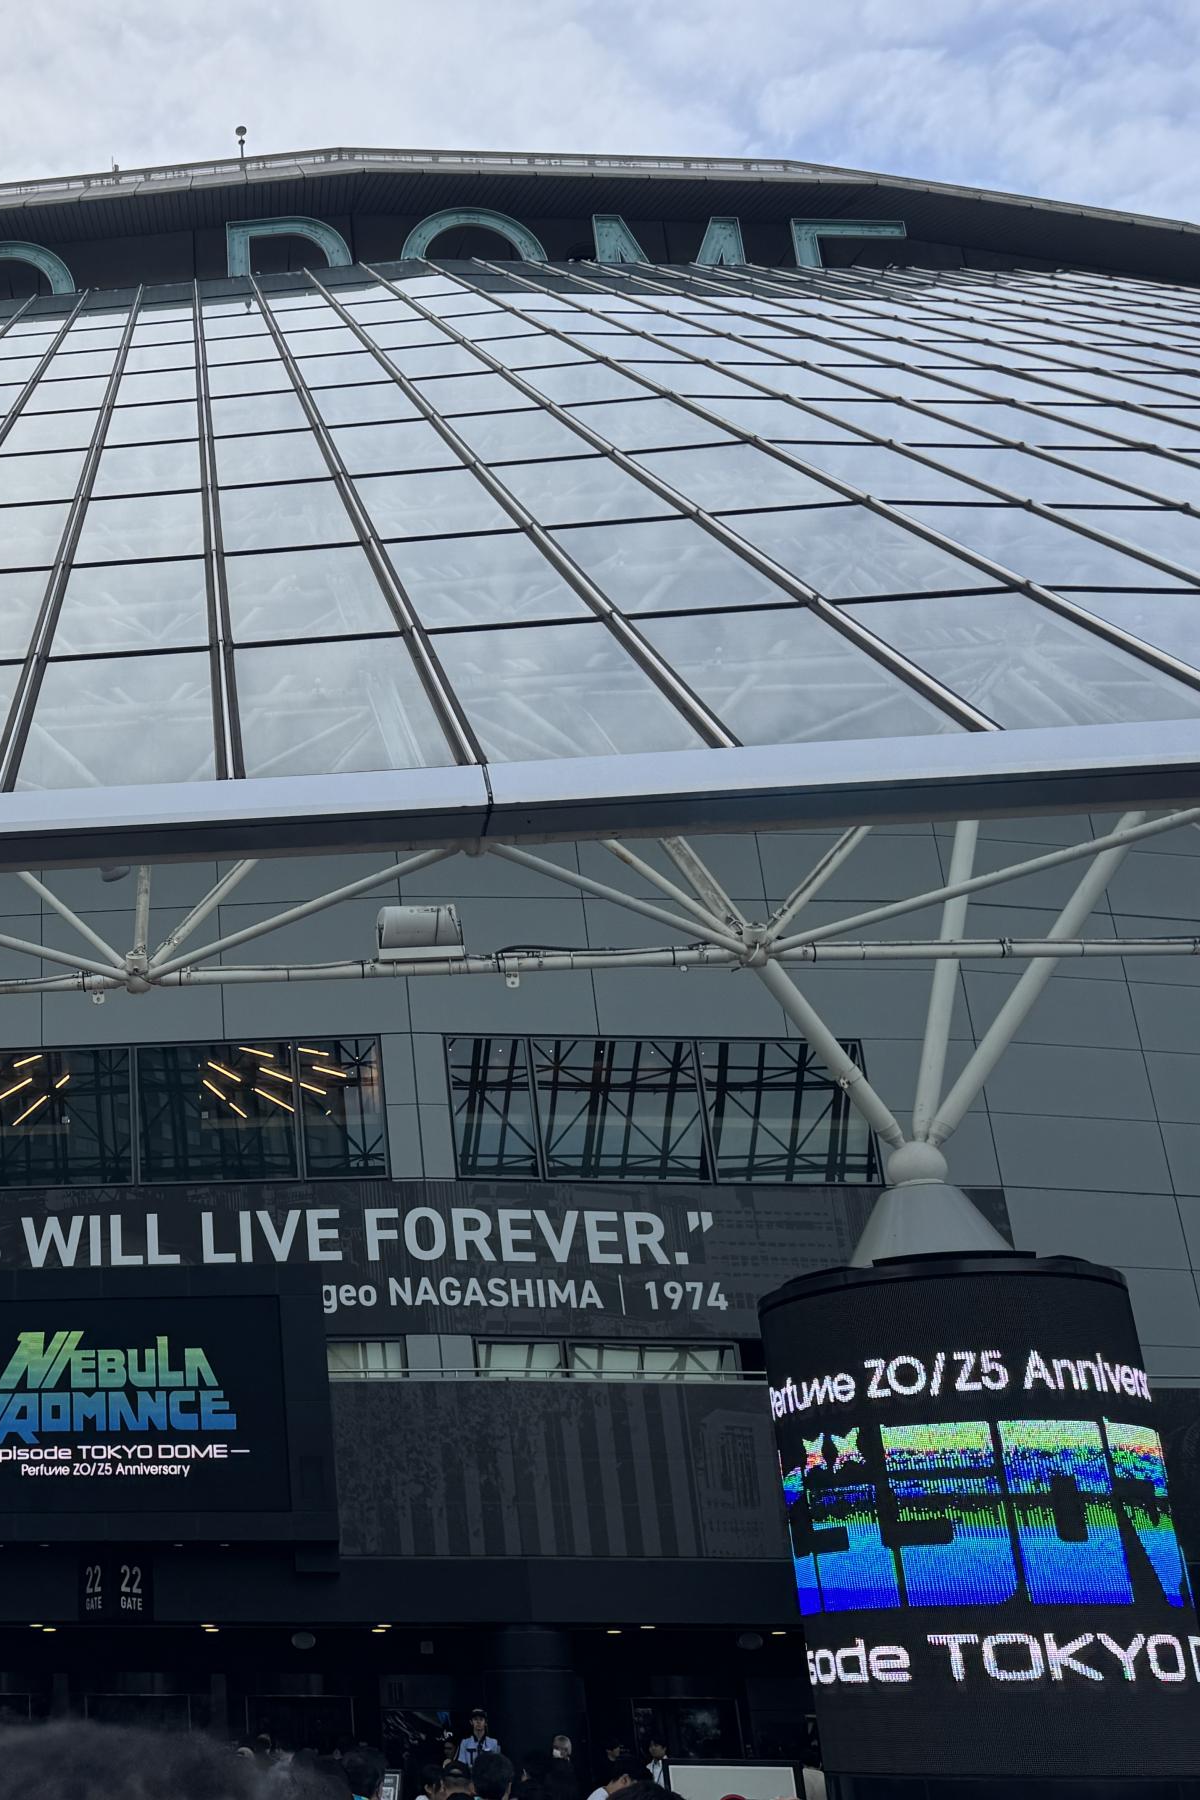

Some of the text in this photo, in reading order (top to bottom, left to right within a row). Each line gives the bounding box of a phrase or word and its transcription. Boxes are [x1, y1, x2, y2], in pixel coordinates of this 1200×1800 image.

[21, 1213, 181, 1269] WILL
[201, 1208, 343, 1264] LIVE
[388, 1276, 604, 1310] NAGASHIMA
[645, 1280, 728, 1311] 1974
[77, 1445, 153, 1460] TOKYO
[21, 1463, 70, 1477] Perfume
[116, 1462, 191, 1478] Anniversary
[85, 1565, 102, 1594] 22
[120, 1565, 142, 1594] 22
[86, 1596, 103, 1611] GATE
[120, 1596, 143, 1611] GATE
[927, 1632, 1186, 1682] TOKYO
